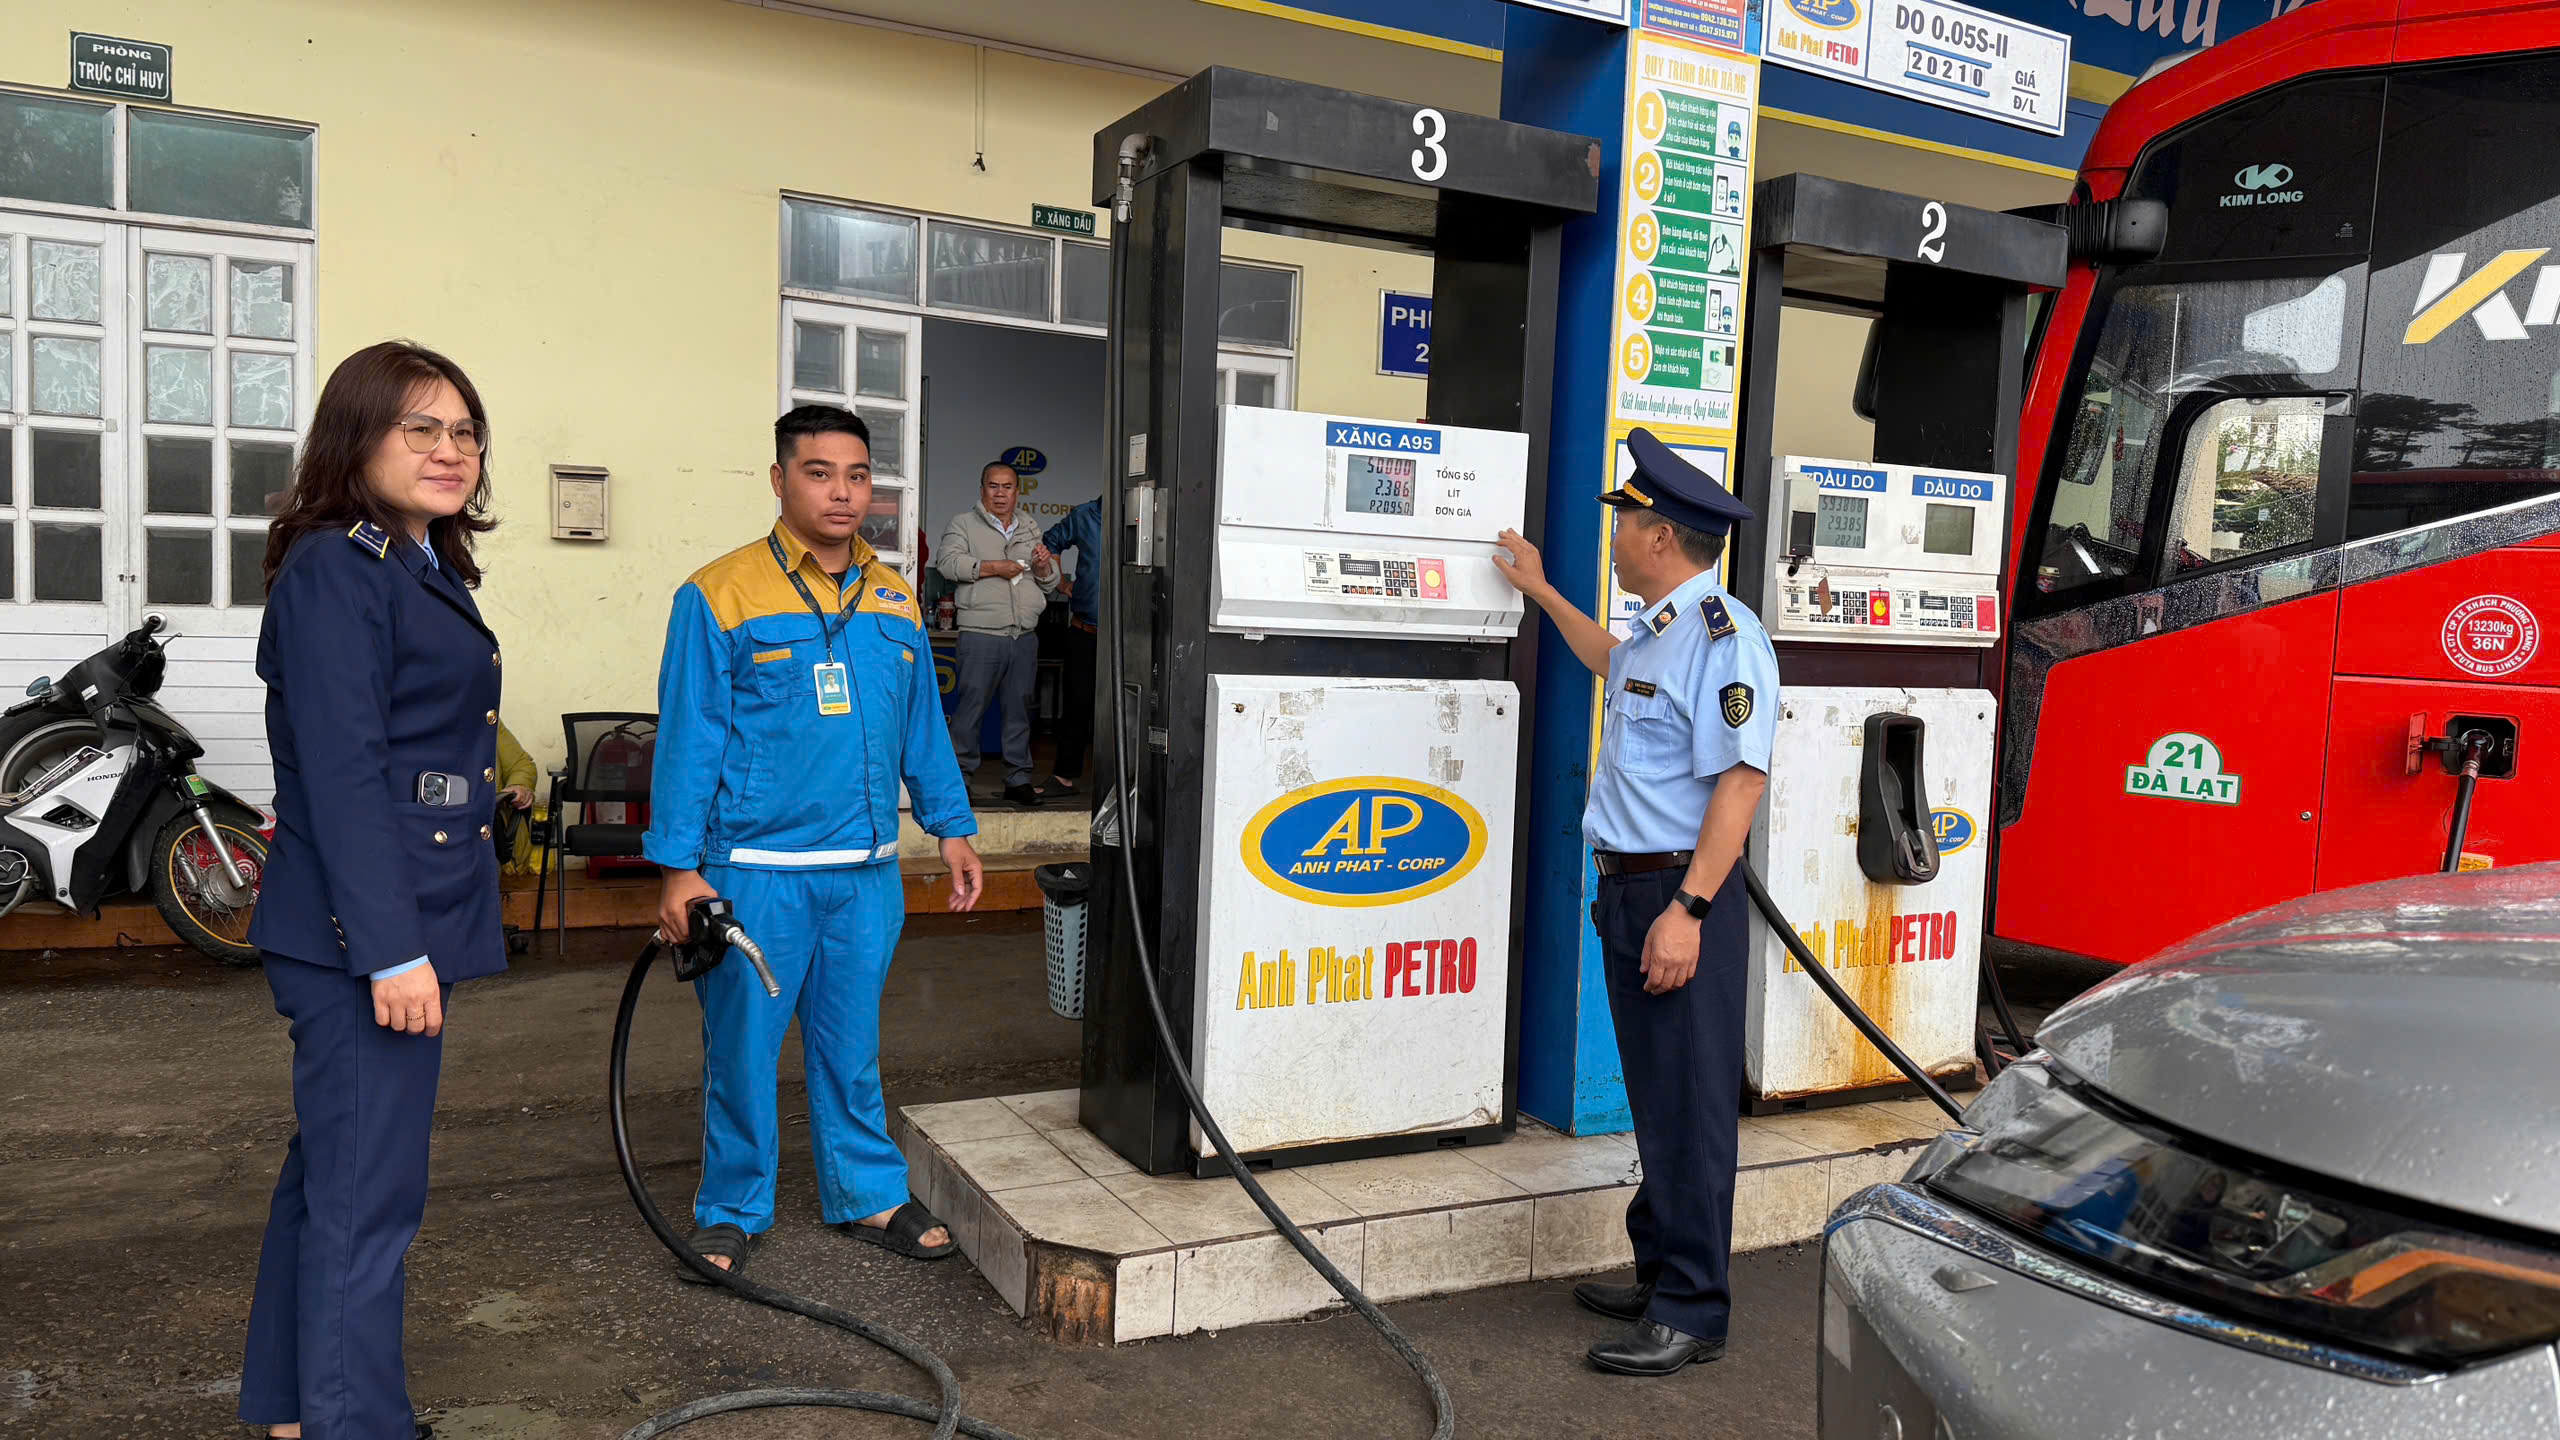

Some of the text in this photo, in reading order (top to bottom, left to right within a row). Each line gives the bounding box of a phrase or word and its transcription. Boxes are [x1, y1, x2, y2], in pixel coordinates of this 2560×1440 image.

[1896, 4, 2009, 59] DO 0.05S-II
[93, 43, 152, 60] PHÒNG
[1778, 27, 1859, 66] Anh Phat PETRO
[78, 61, 164, 90] TRỰC CHỈ HUY
[1911, 50, 1983, 88] 20210
[2014, 69, 2037, 90] GIÁ
[1644, 102, 1657, 131] 1
[2013, 94, 2037, 115] Đ/L
[1411, 108, 1448, 182] 3
[1639, 162, 1656, 191] 2
[2219, 190, 2304, 208] KIM LONG
[1035, 209, 1044, 223] P.
[1047, 211, 1071, 228] XĂNG
[1635, 222, 1652, 252] 3
[1917, 200, 1947, 265] 2
[1631, 282, 1649, 311] 4
[1629, 342, 1644, 372] 5
[1335, 426, 1433, 451] XĂNG A95
[1011, 449, 1037, 466] AP
[1367, 456, 1412, 476] 50000
[1375, 478, 1410, 498] 2.386
[1851, 474, 1875, 489] DO
[1960, 484, 1982, 498] DO
[1435, 506, 1455, 516] ĐƠN
[2447, 632, 2456, 648] CTY
[2454, 610, 2467, 621] XE
[2465, 597, 2498, 613] KHÁCH
[2500, 600, 2531, 625] PHƯƠNG
[2521, 625, 2535, 652] TRANG
[2467, 620, 2514, 636] 13230kg
[2471, 637, 2505, 651] 36N
[2454, 653, 2523, 673] FUTA BUS LINES
[1727, 687, 1747, 697] DMS
[2163, 741, 2204, 770] 21
[87, 772, 124, 783] HONDA
[2132, 769, 2234, 800] ĐÀ LẠT
[1296, 796, 1424, 856] AP
[1289, 857, 1446, 875] ANH PHAT CORP
[1889, 911, 1957, 964] PETRO
[1236, 936, 1477, 1010] Anh Phat PETRO
